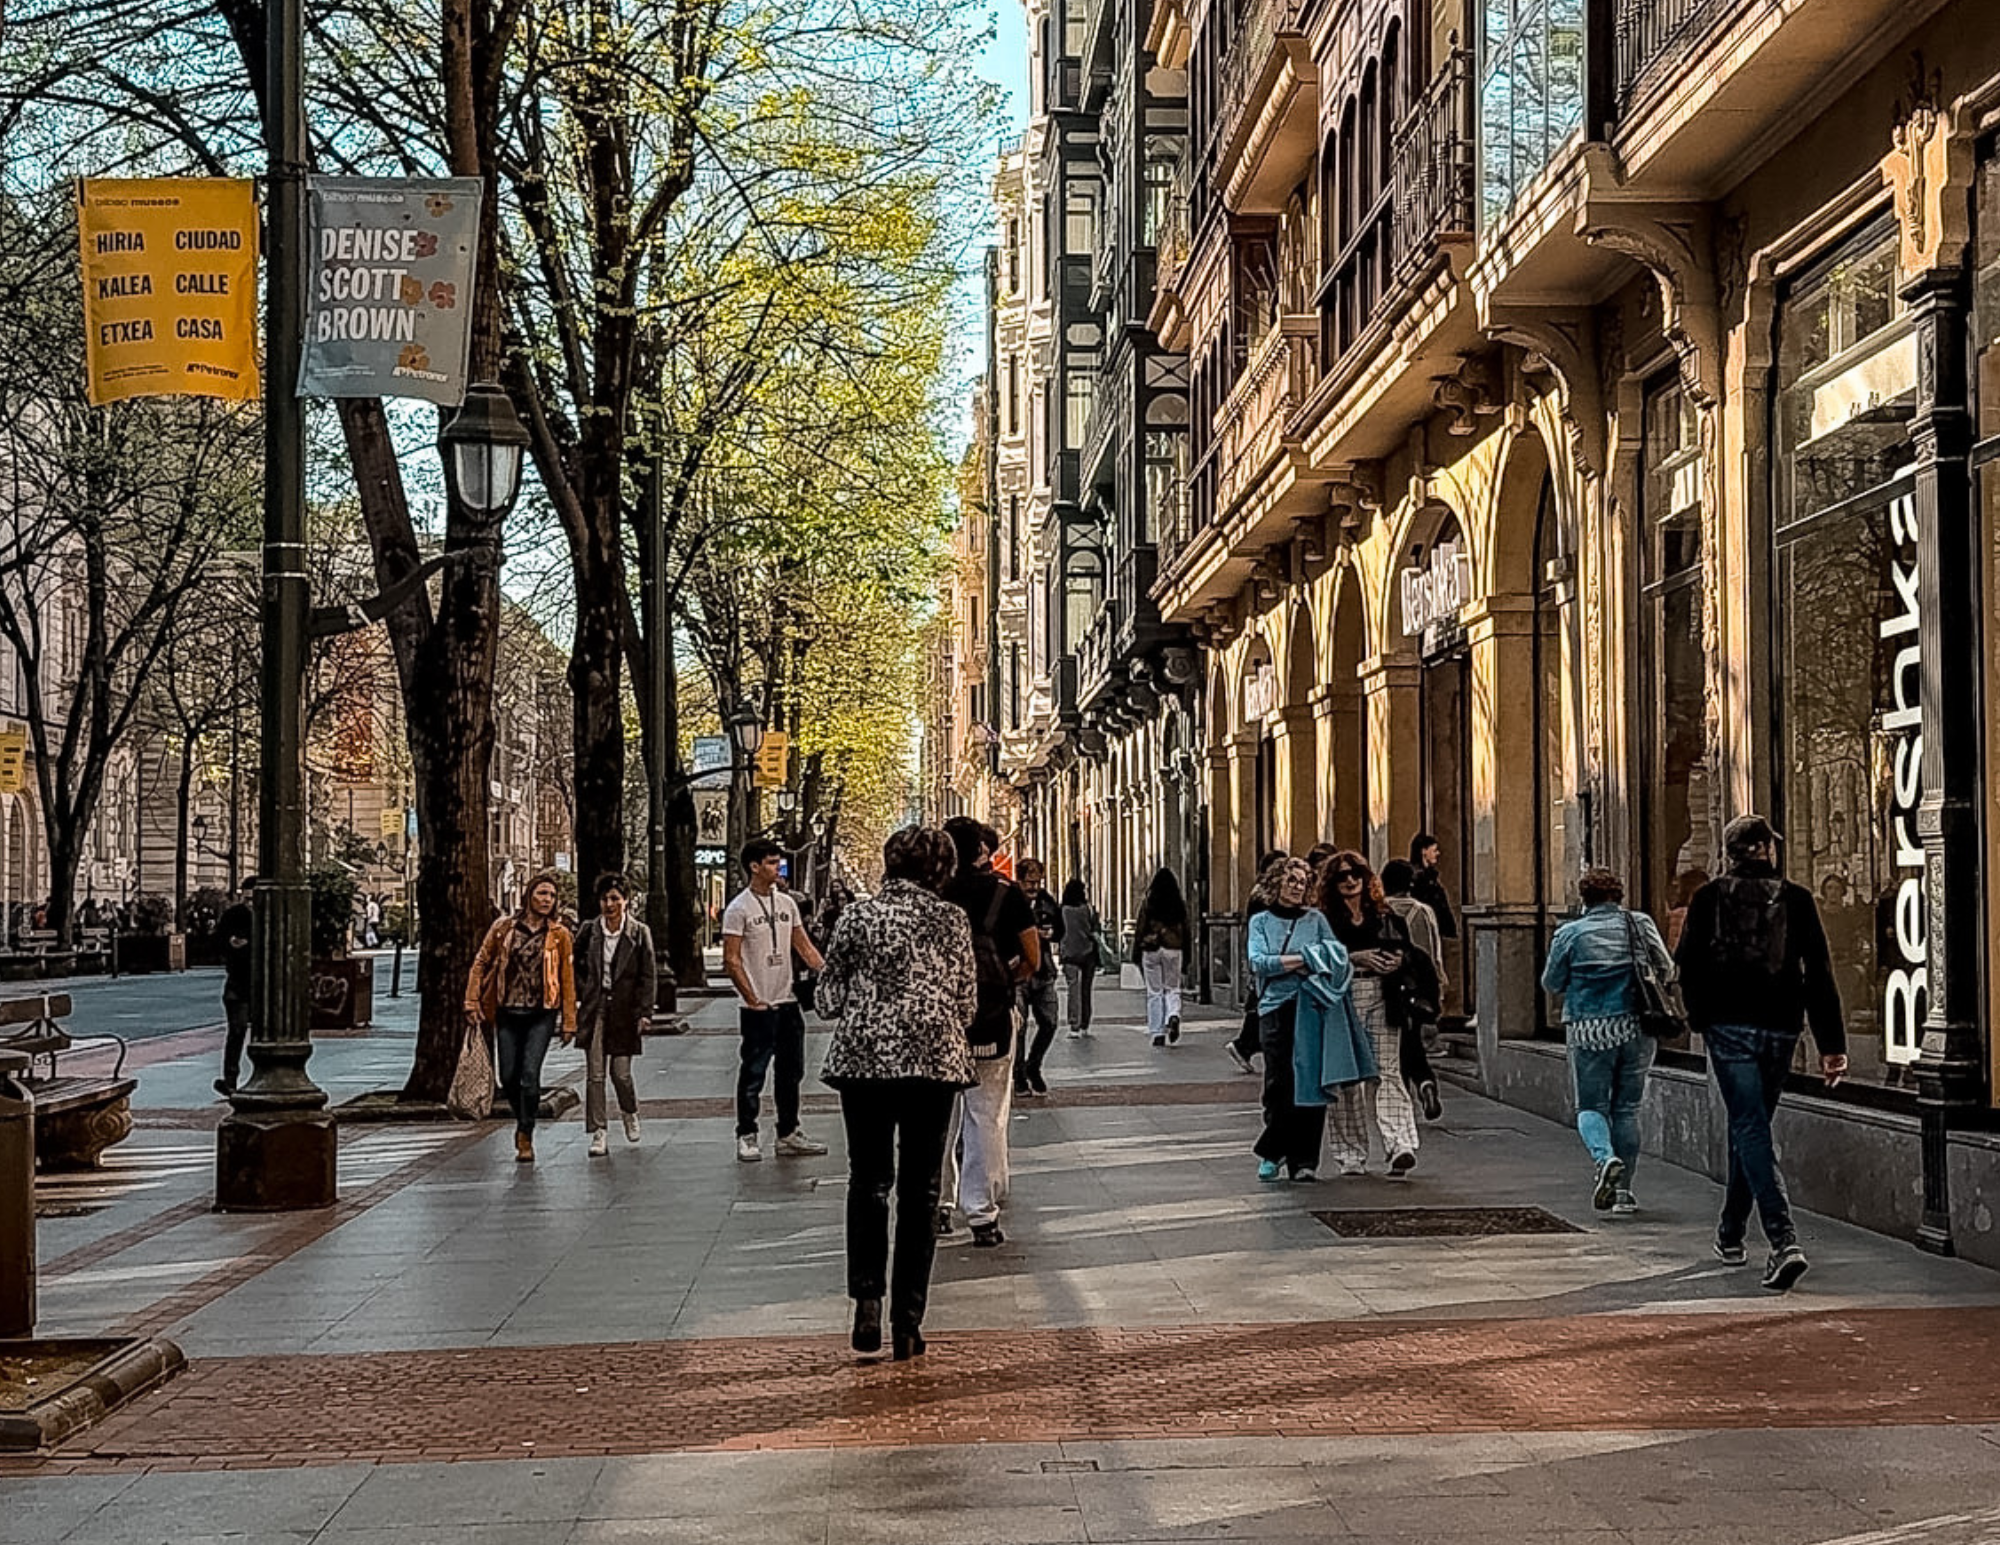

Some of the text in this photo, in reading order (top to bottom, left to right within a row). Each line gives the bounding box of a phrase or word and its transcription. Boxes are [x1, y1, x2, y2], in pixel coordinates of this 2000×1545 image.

[97, 232, 145, 254] HIRIA
[176, 230, 241, 250] CIUDAD
[321, 228, 418, 261] DENISE
[99, 275, 152, 299] KALEA
[176, 274, 228, 294] CALLE
[319, 267, 408, 302] SCOTT
[101, 320, 153, 346] ETXEA
[177, 319, 223, 340] CASA
[318, 306, 415, 343] BROWN
